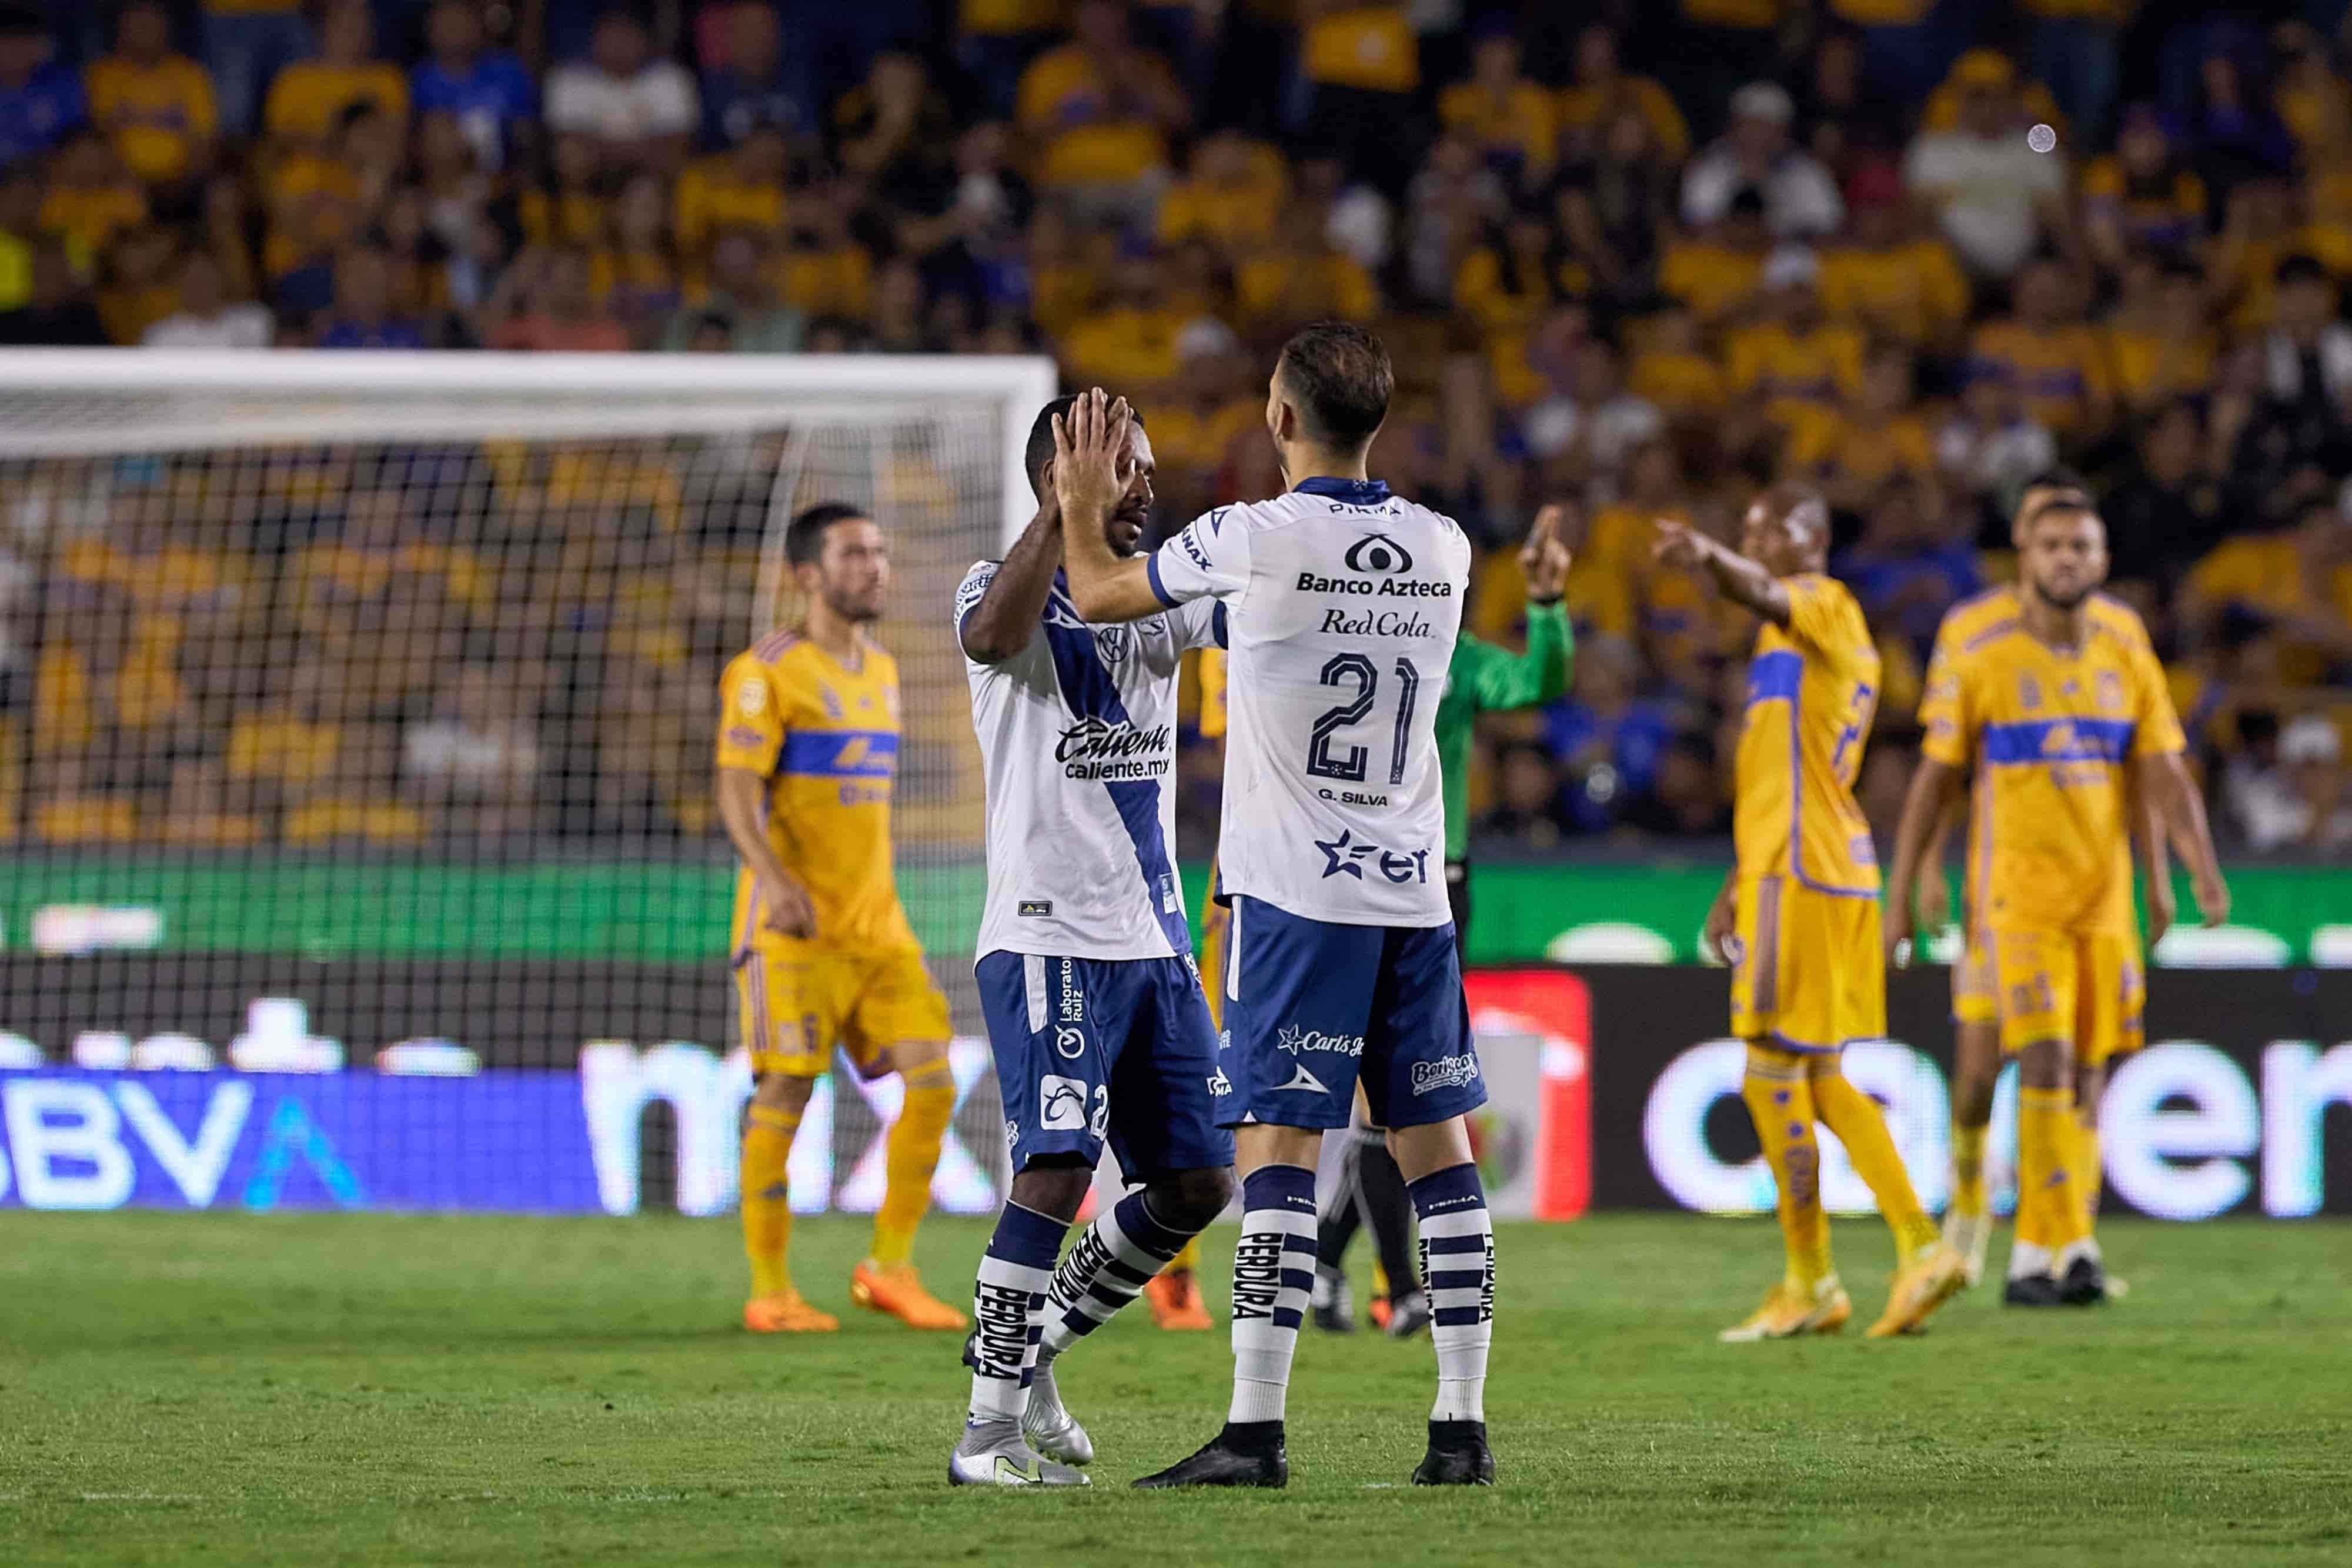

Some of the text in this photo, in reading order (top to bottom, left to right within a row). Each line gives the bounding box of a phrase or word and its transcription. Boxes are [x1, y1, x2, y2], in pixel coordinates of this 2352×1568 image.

[1296, 572, 1451, 597] Banco Azteca
[1306, 653, 1419, 785] 21
[1055, 717, 1170, 763] Caliente
[1065, 758, 1170, 779] caliente.mx
[1318, 788, 1388, 807] G. SILVA
[1073, 990, 1083, 1021] Ruiz
[1232, 1233, 1284, 1319] PERDURA
[981, 1282, 1031, 1380] PERDURA
